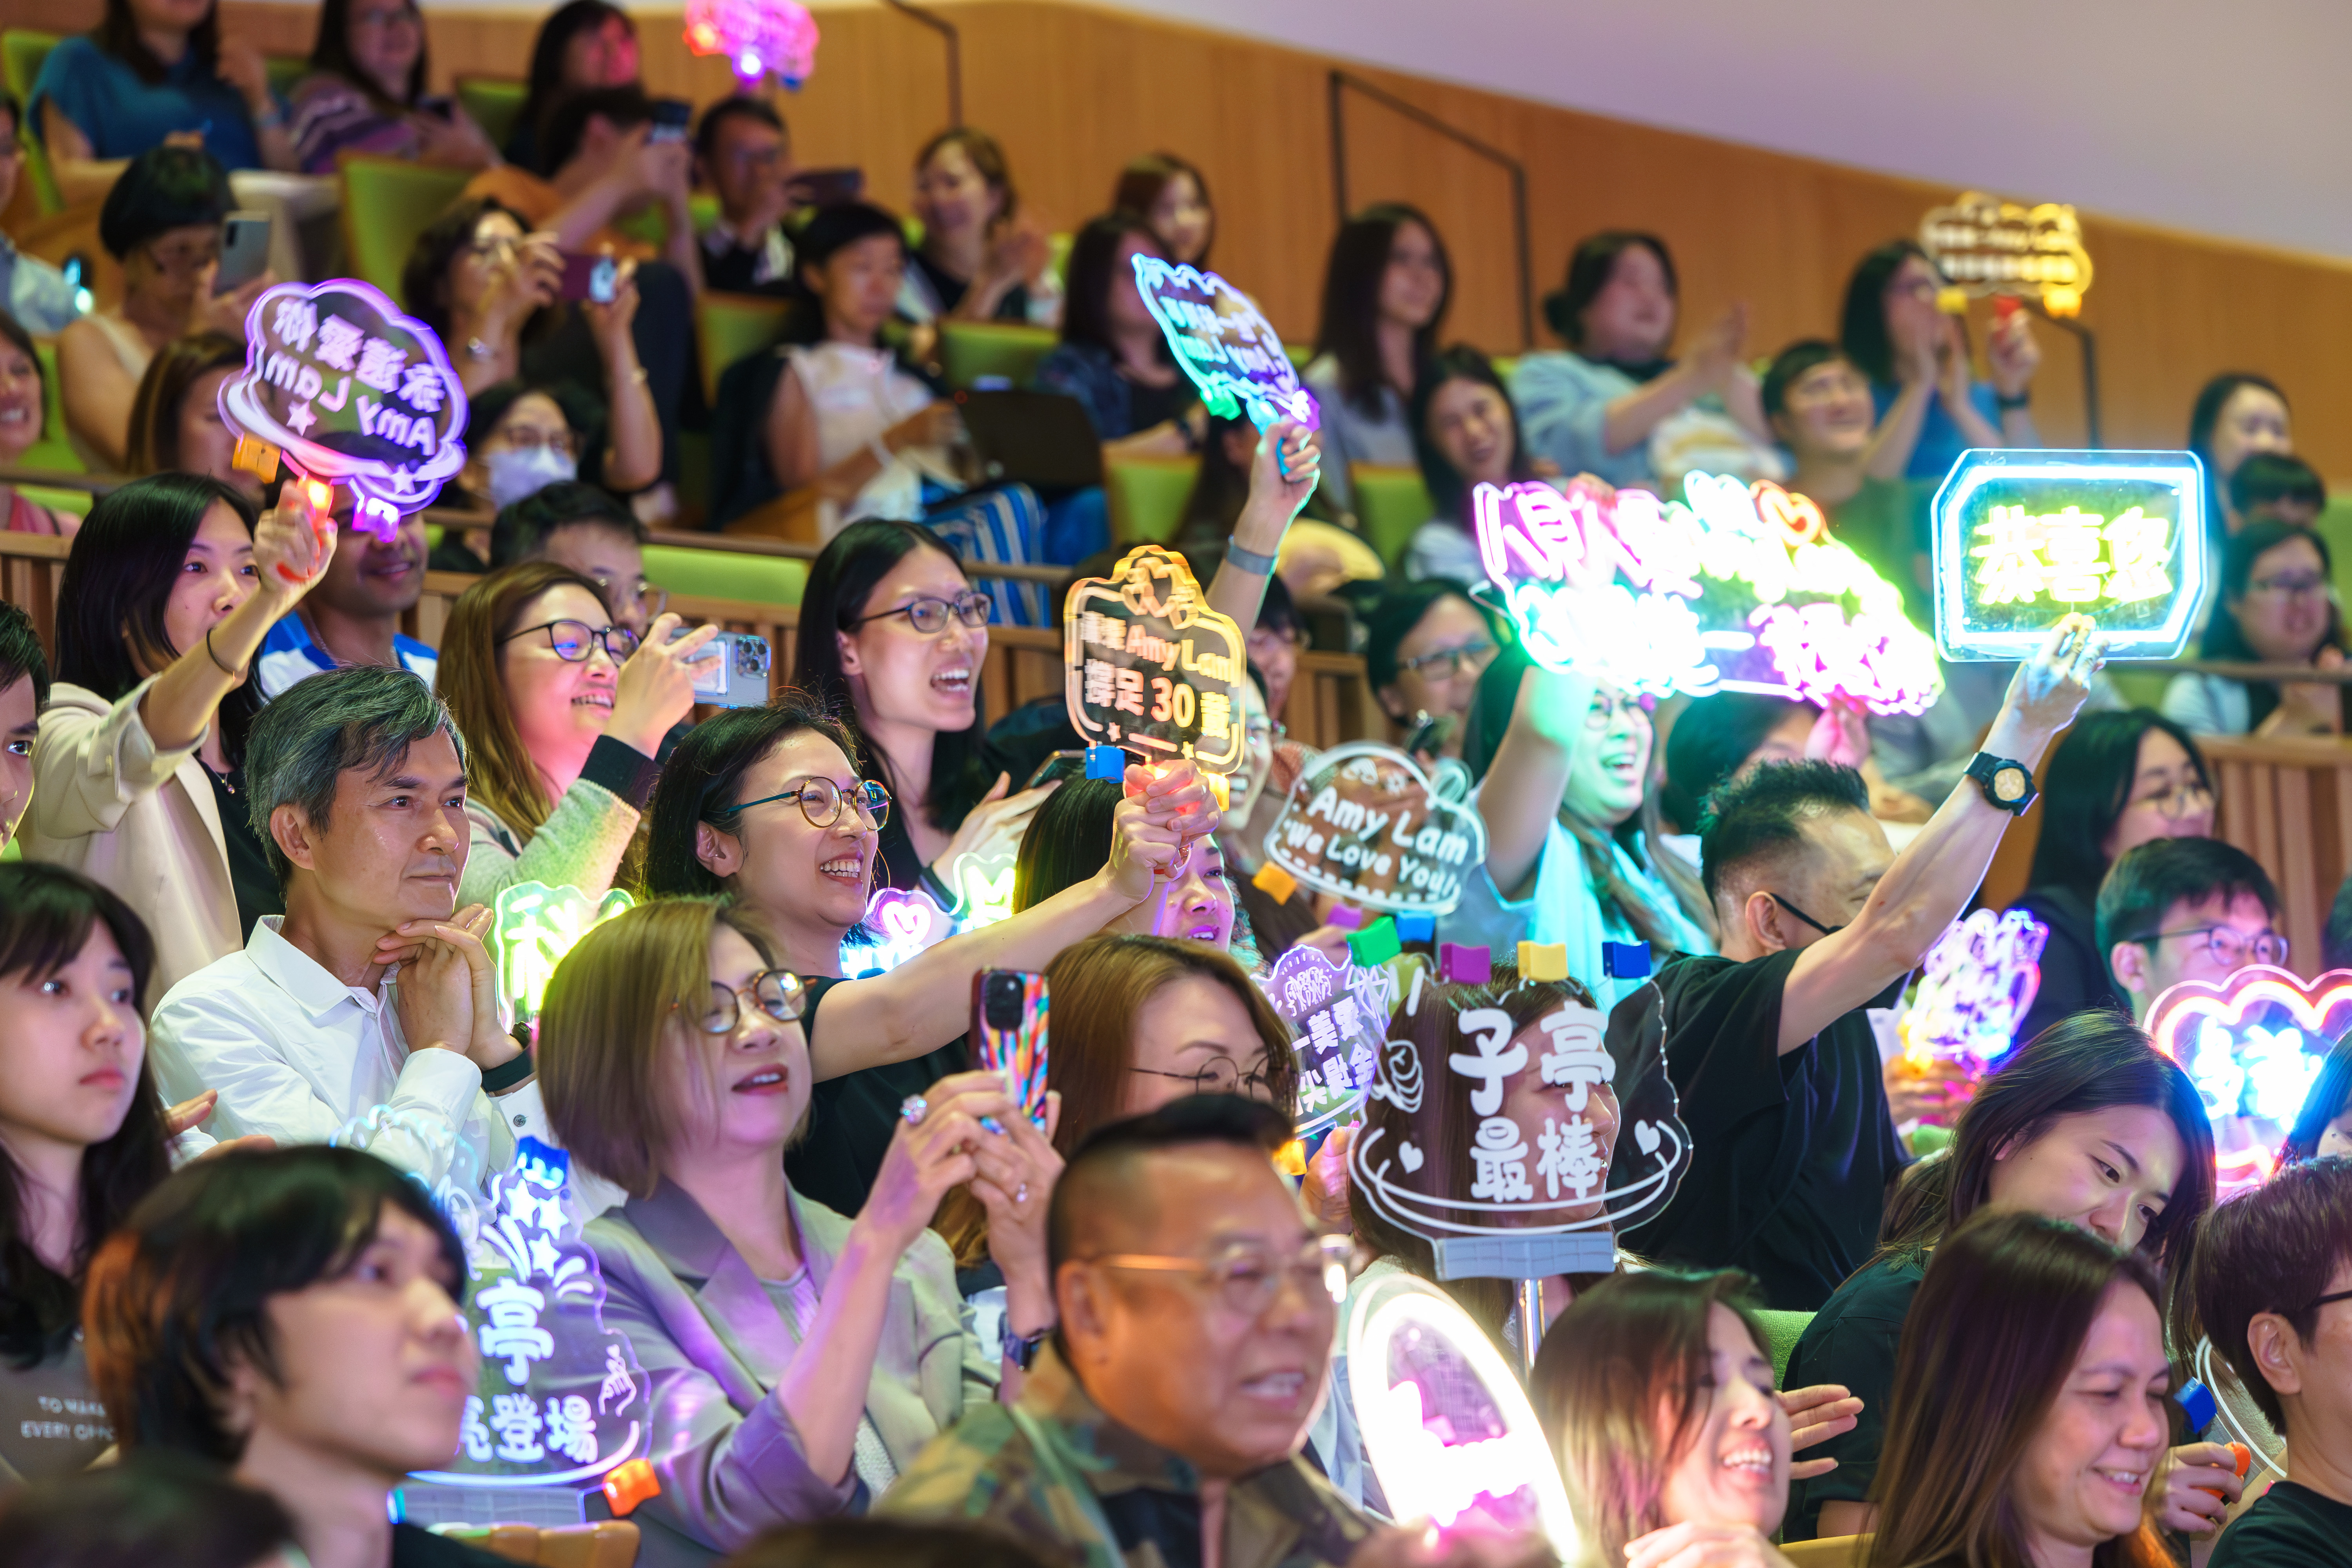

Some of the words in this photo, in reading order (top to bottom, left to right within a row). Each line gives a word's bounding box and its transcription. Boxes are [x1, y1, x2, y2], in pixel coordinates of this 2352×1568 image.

[1969, 504, 2173, 605] 恭喜您
[1126, 624, 1181, 671] Amy
[1181, 639, 1241, 688] Lam
[1150, 677, 1196, 728] 30
[1287, 820, 1325, 854] We
[1326, 835, 1392, 876] Love
[1306, 786, 1390, 842] Amy
[1392, 811, 1469, 865] Lam
[1448, 1000, 1616, 1116] 子亭
[1469, 1115, 1603, 1203] 最棒
[476, 1276, 555, 1386] 亭
